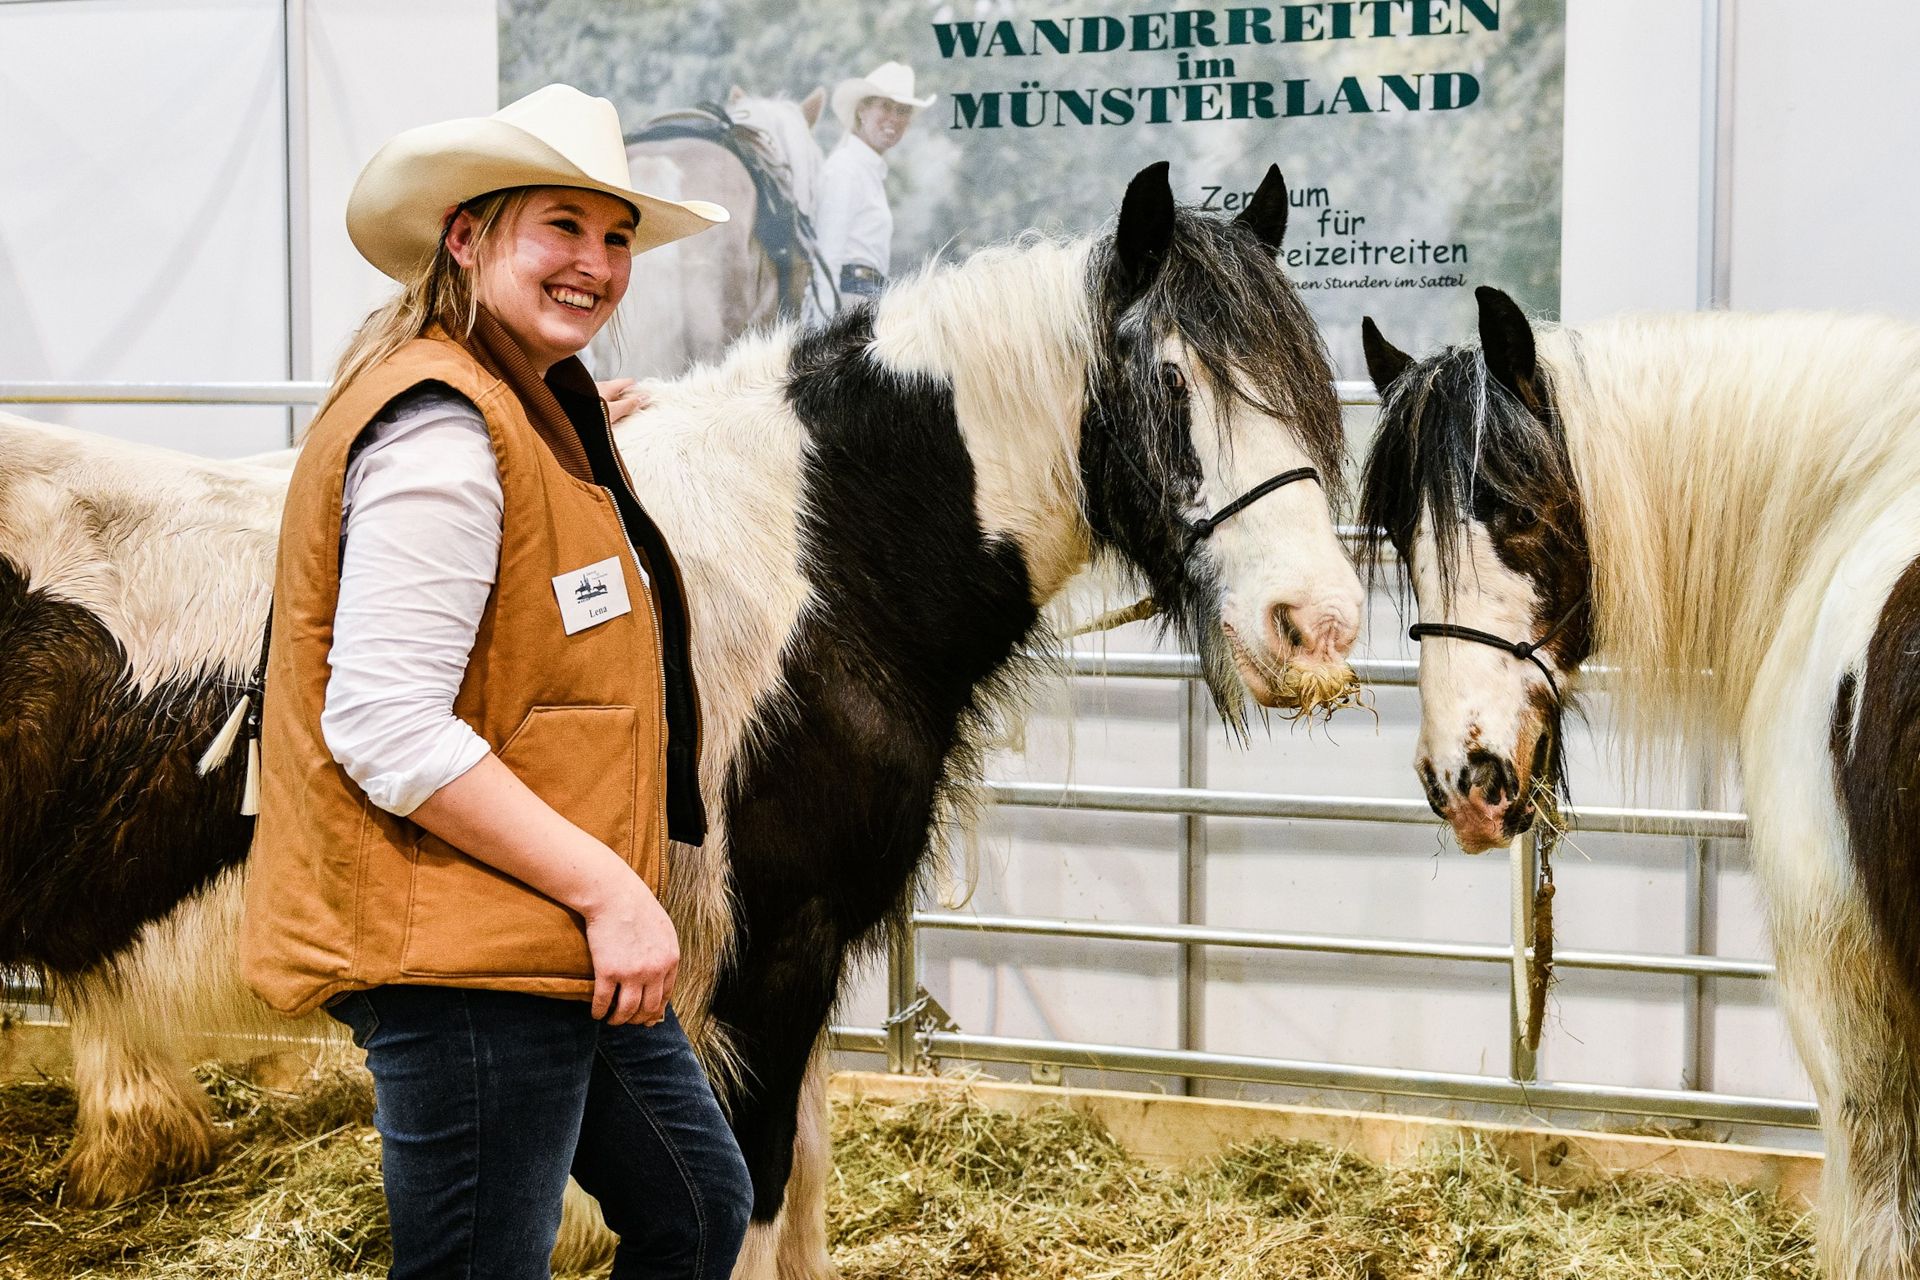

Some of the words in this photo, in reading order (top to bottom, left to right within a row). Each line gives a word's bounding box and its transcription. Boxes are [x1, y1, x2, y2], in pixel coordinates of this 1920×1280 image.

[932, 0, 1500, 58] WANDERREITEN
[1177, 52, 1235, 80] im
[950, 71, 1480, 130] MÜNSTERLAND
[1201, 186, 1330, 211] Zenum
[1317, 209, 1365, 238] für
[1281, 239, 1468, 267] eizeitreiten
[1323, 275, 1391, 290] Stunden
[1394, 275, 1417, 289] im
[1418, 273, 1467, 289] Sattel
[588, 606, 608, 618] Lena
